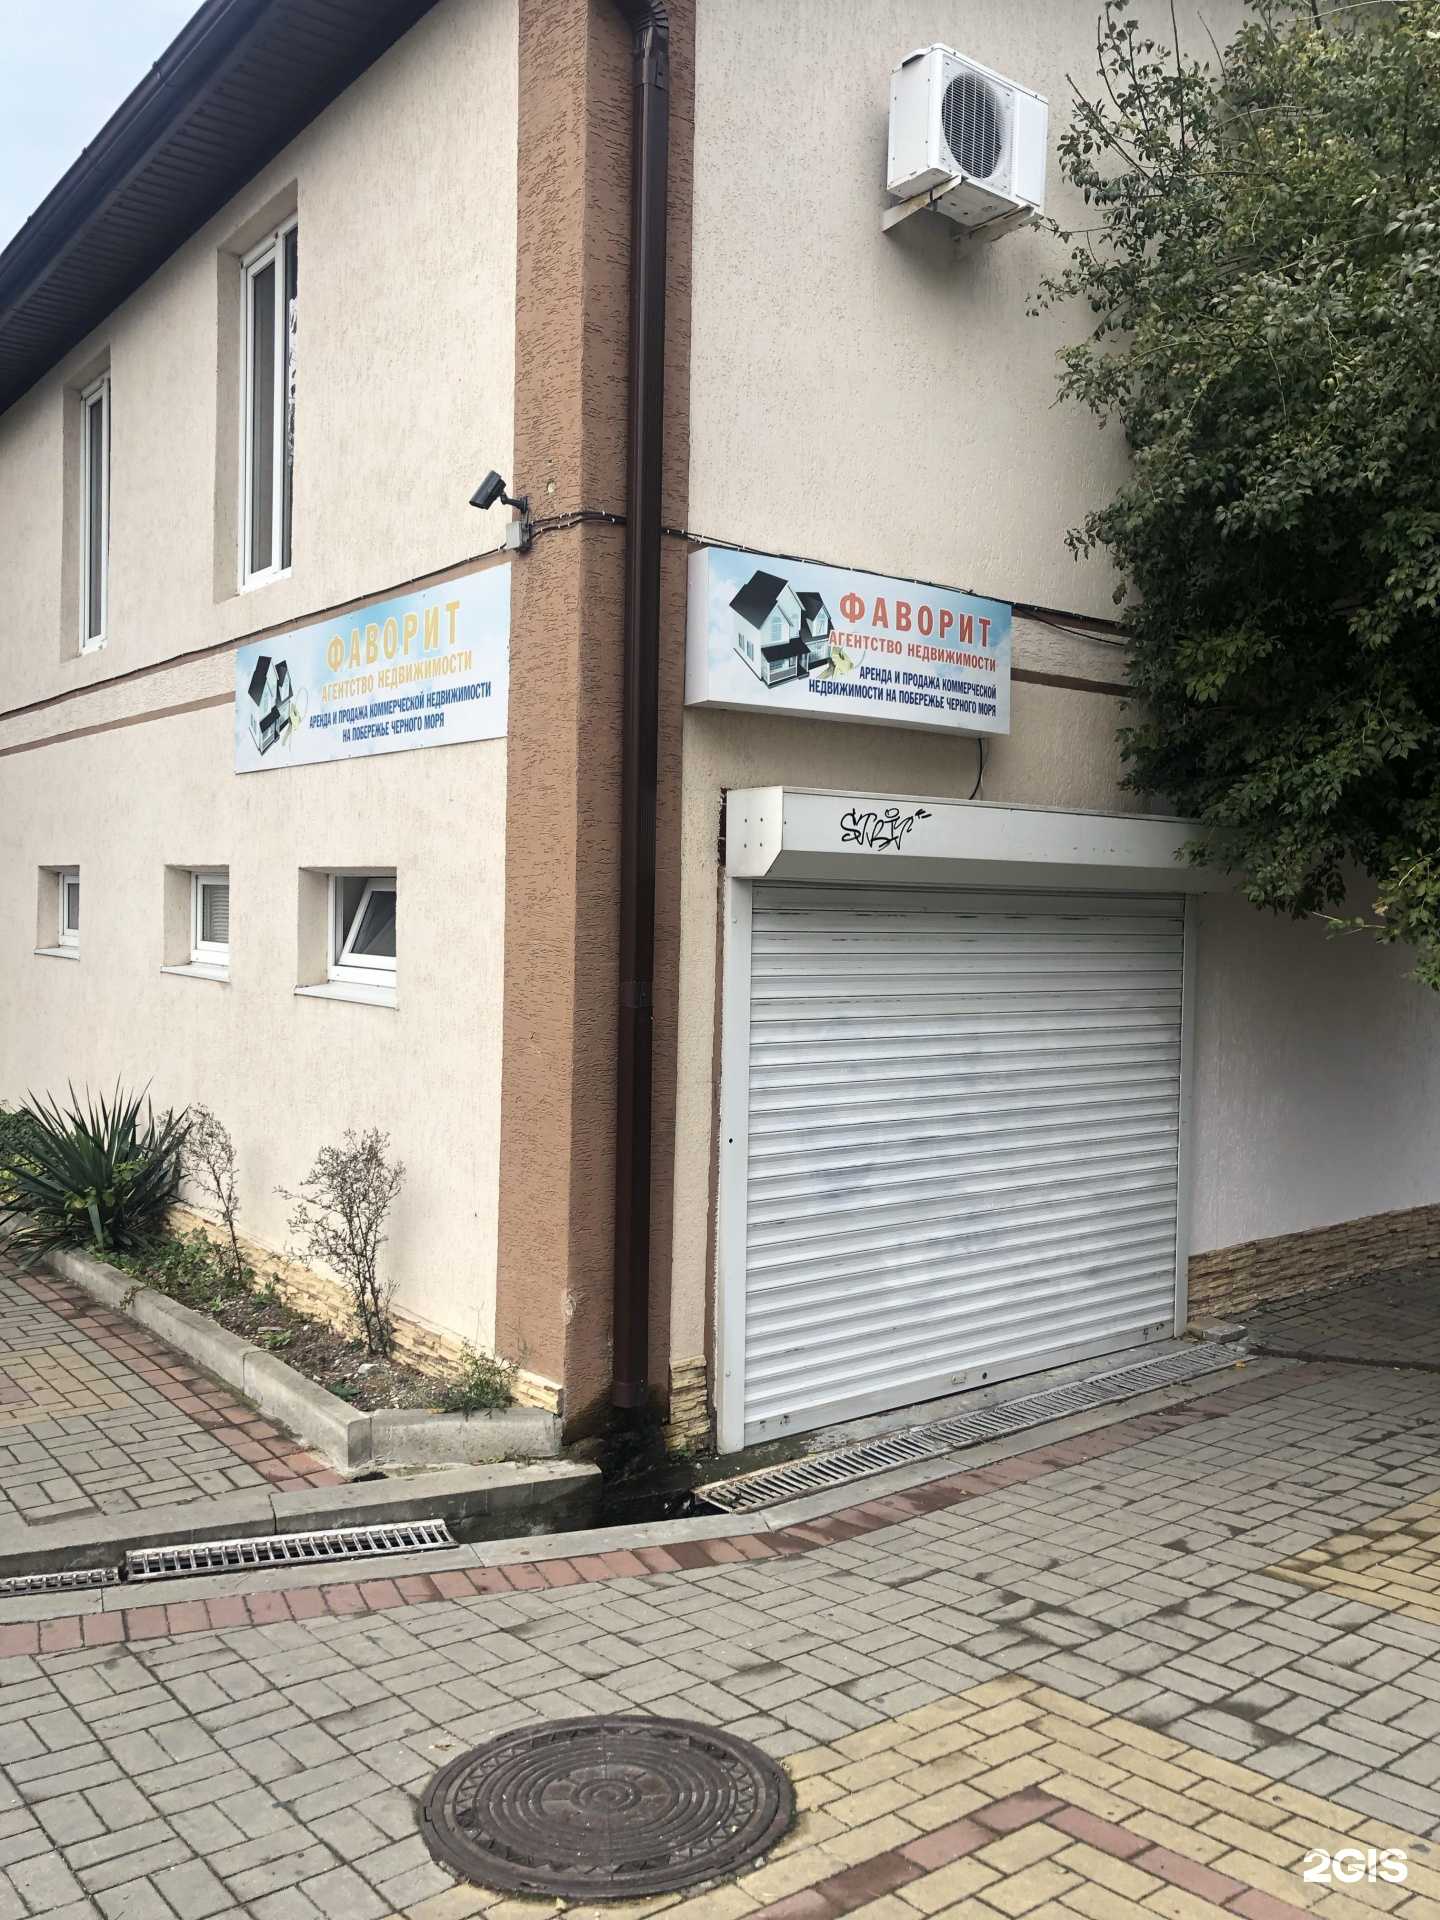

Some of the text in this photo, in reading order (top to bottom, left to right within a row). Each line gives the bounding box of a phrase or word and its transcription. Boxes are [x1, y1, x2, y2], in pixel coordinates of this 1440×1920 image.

[326, 600, 461, 672] ФАВОРИТ
[839, 592, 992, 647] ФАВОРИТ
[829, 630, 996, 672] АГЕНТСТВО НЕДВИЖИМОСТИ
[322, 651, 472, 704] АГЕНТСТВО НЕДВИЖИМОСТИ
[809, 679, 997, 717] НЕДВИЖИМОСТИ НА ПОБЕРЕЖЬЕ ЧЕРНОГО МОРЯ
[860, 666, 997, 699] АРЕНДА И ПРОДАЖА КОММЕРЧЕСКОЙ
[309, 681, 492, 729] АРЕНДА И ПРОДАЖА КОММЕРЧЕСКОЙ НЕДВИЖИМОСТИ
[343, 712, 445, 742] НА ПОБЕРЕЖЬЕ ЧЕРНОГО МОРЯ
